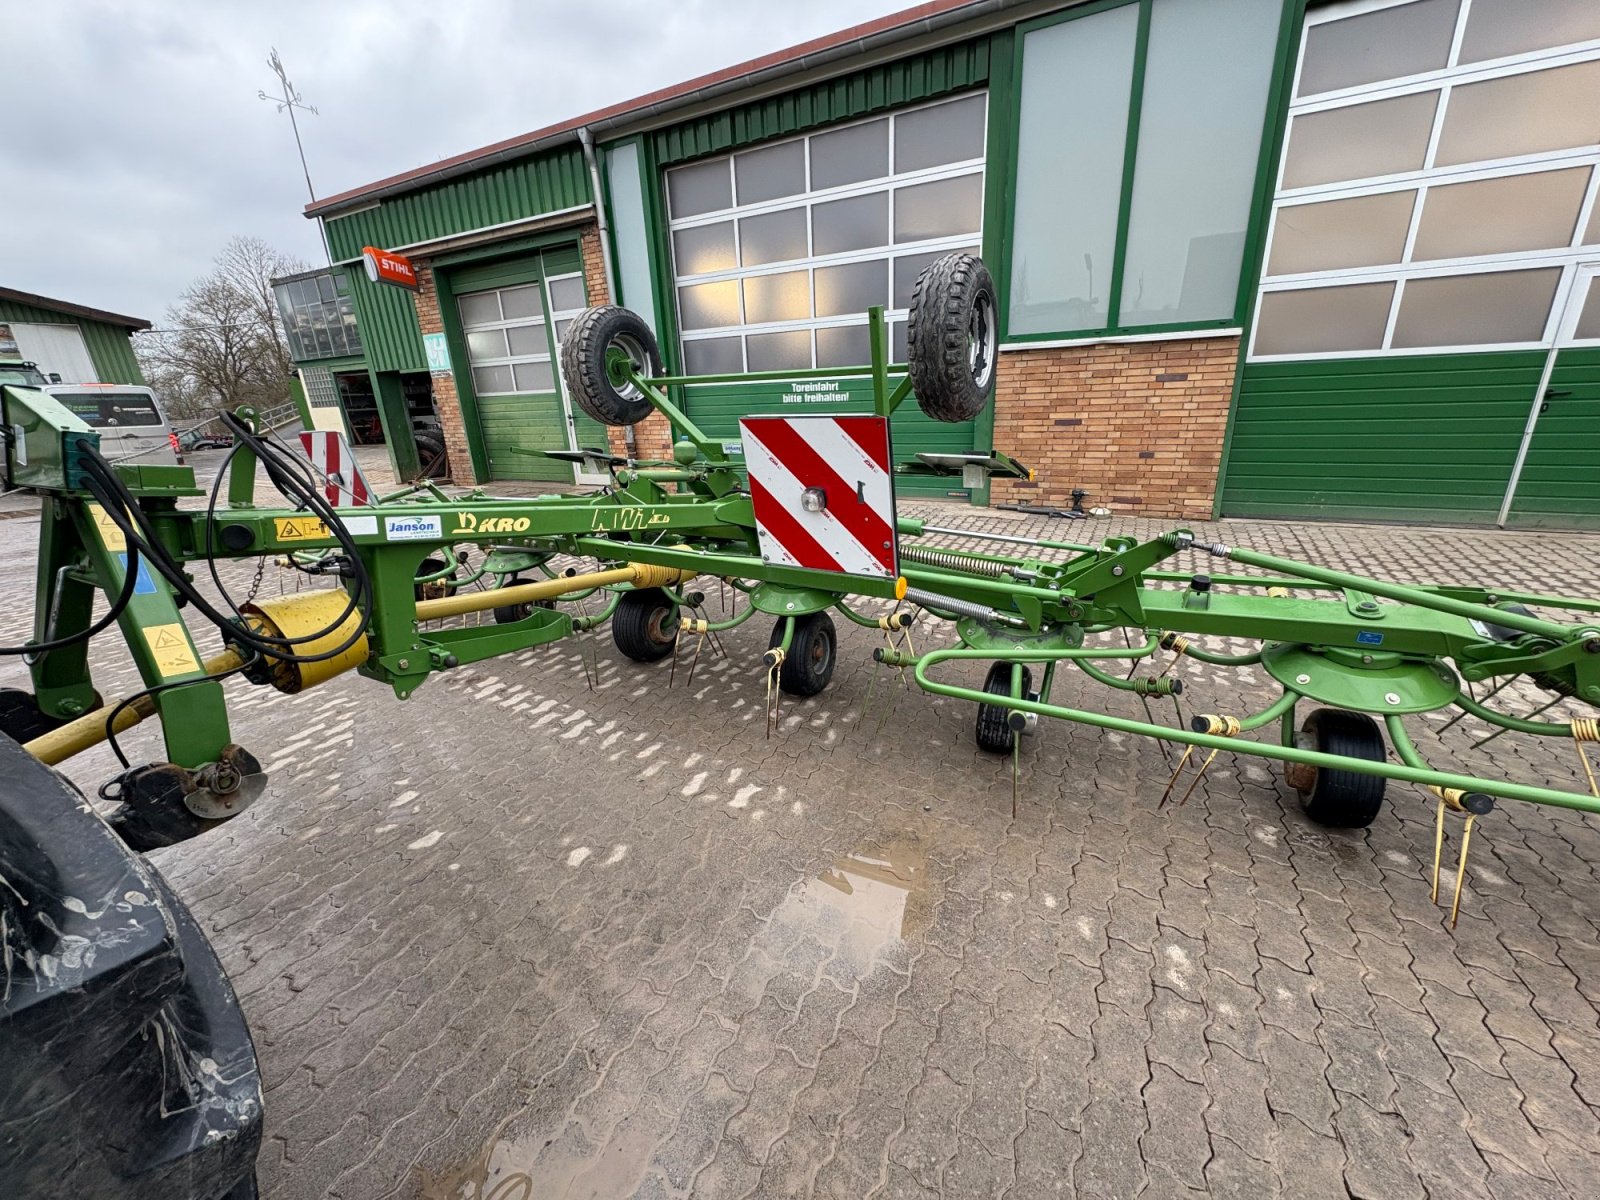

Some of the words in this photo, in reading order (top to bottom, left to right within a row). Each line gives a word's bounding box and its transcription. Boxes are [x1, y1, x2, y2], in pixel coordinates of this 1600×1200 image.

[382, 258, 412, 276] STIHL
[791, 382, 839, 393] Toreinfahrt
[782, 393, 802, 403] bitte
[804, 392, 849, 402] freihalten!
[389, 522, 434, 532] Janson
